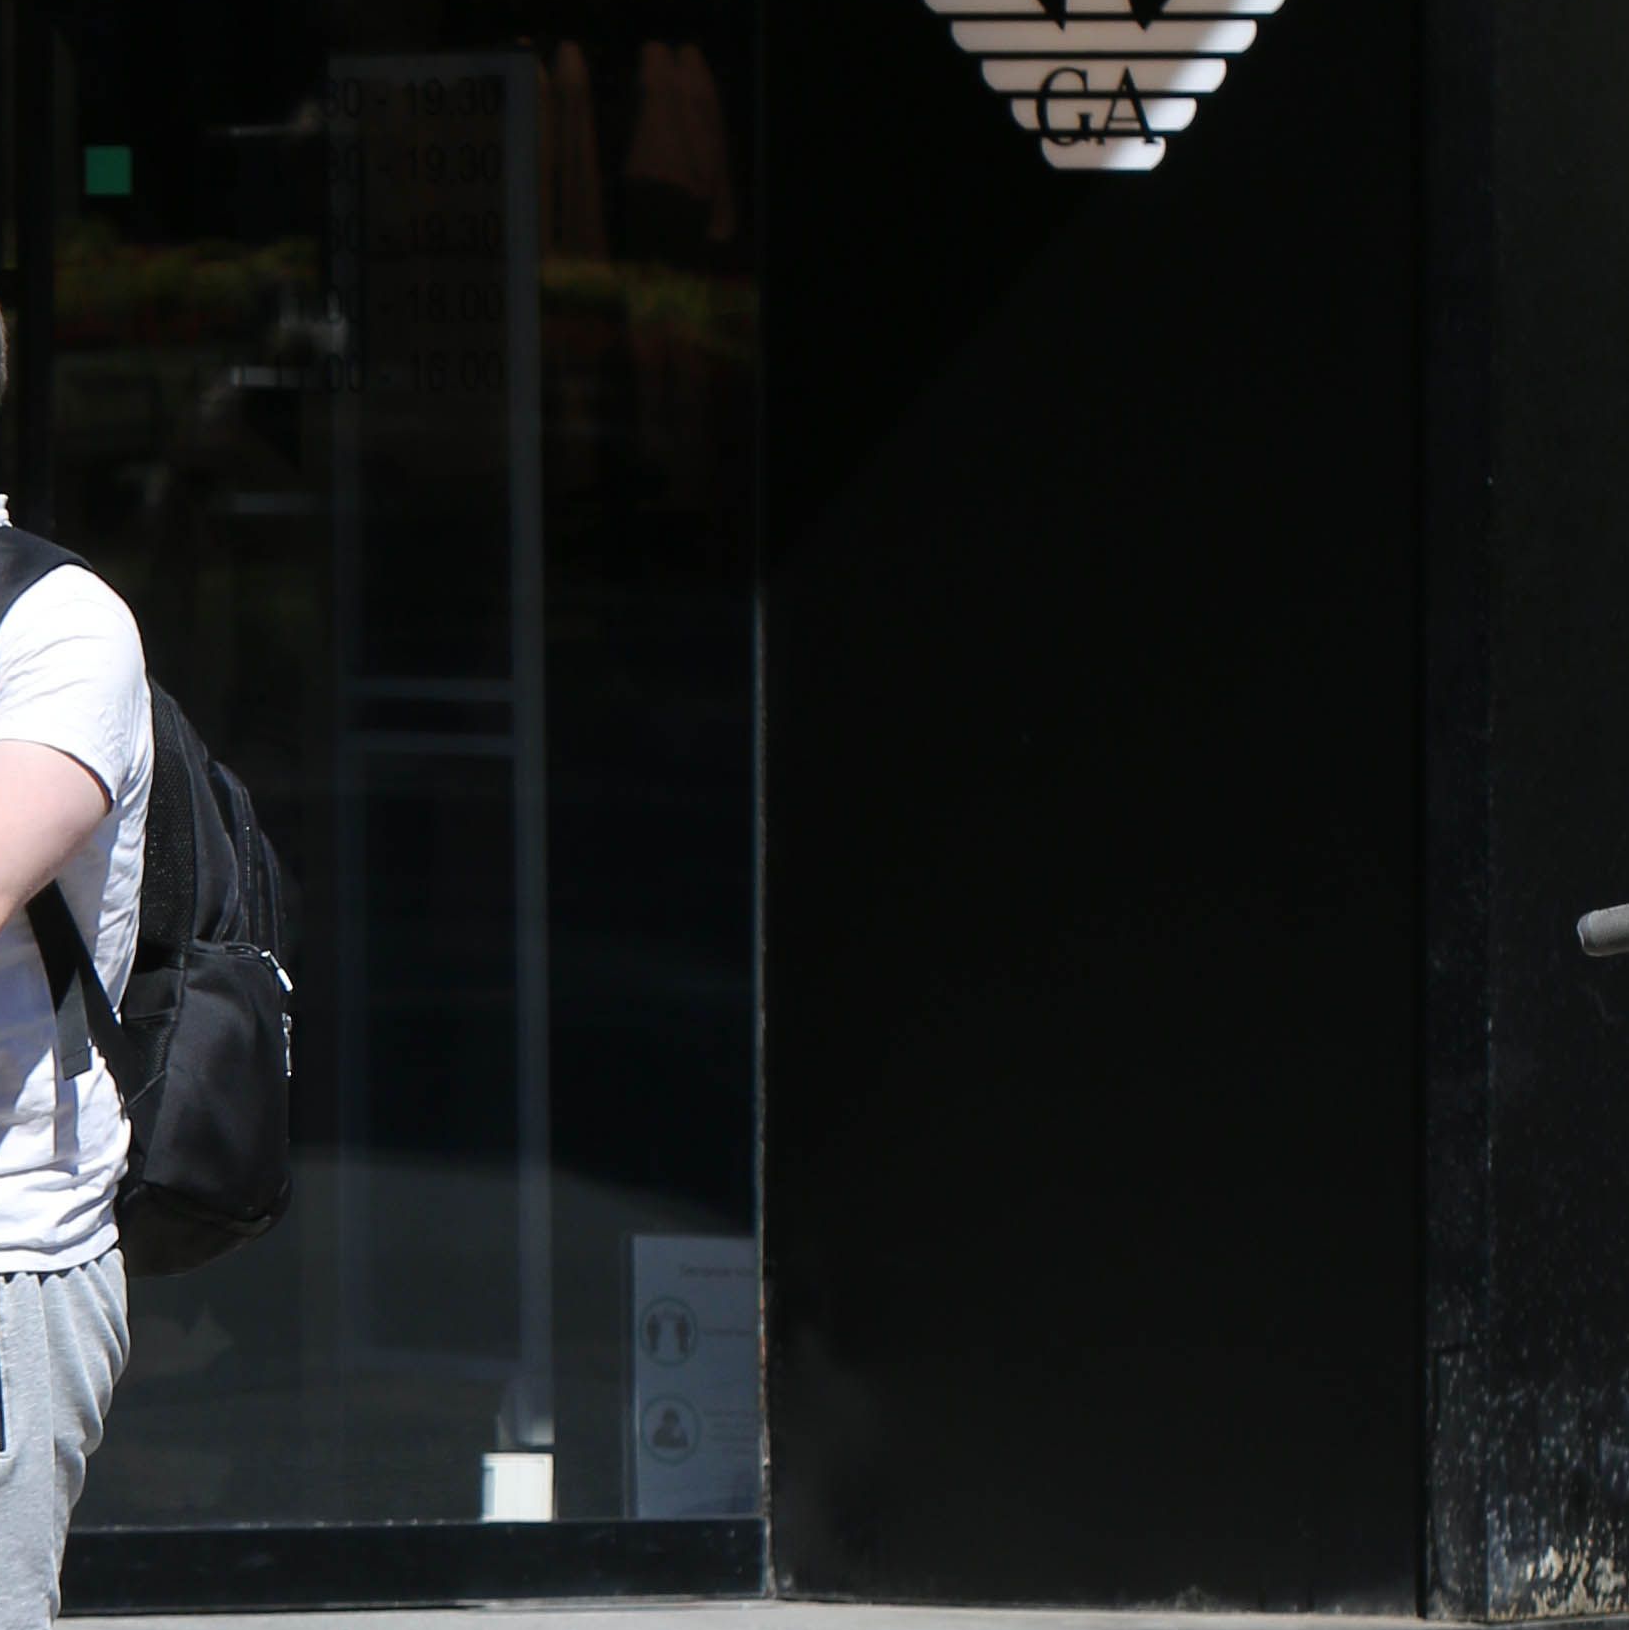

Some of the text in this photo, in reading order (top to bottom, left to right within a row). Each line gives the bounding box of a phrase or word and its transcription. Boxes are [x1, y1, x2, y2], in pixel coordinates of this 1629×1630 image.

[404, 77, 503, 117] 19.30
[1037, 68, 1159, 146] GA
[405, 143, 503, 184] 19.30
[408, 211, 503, 255] 19.30
[405, 282, 504, 324] 18.00
[409, 351, 504, 393] 16.00
